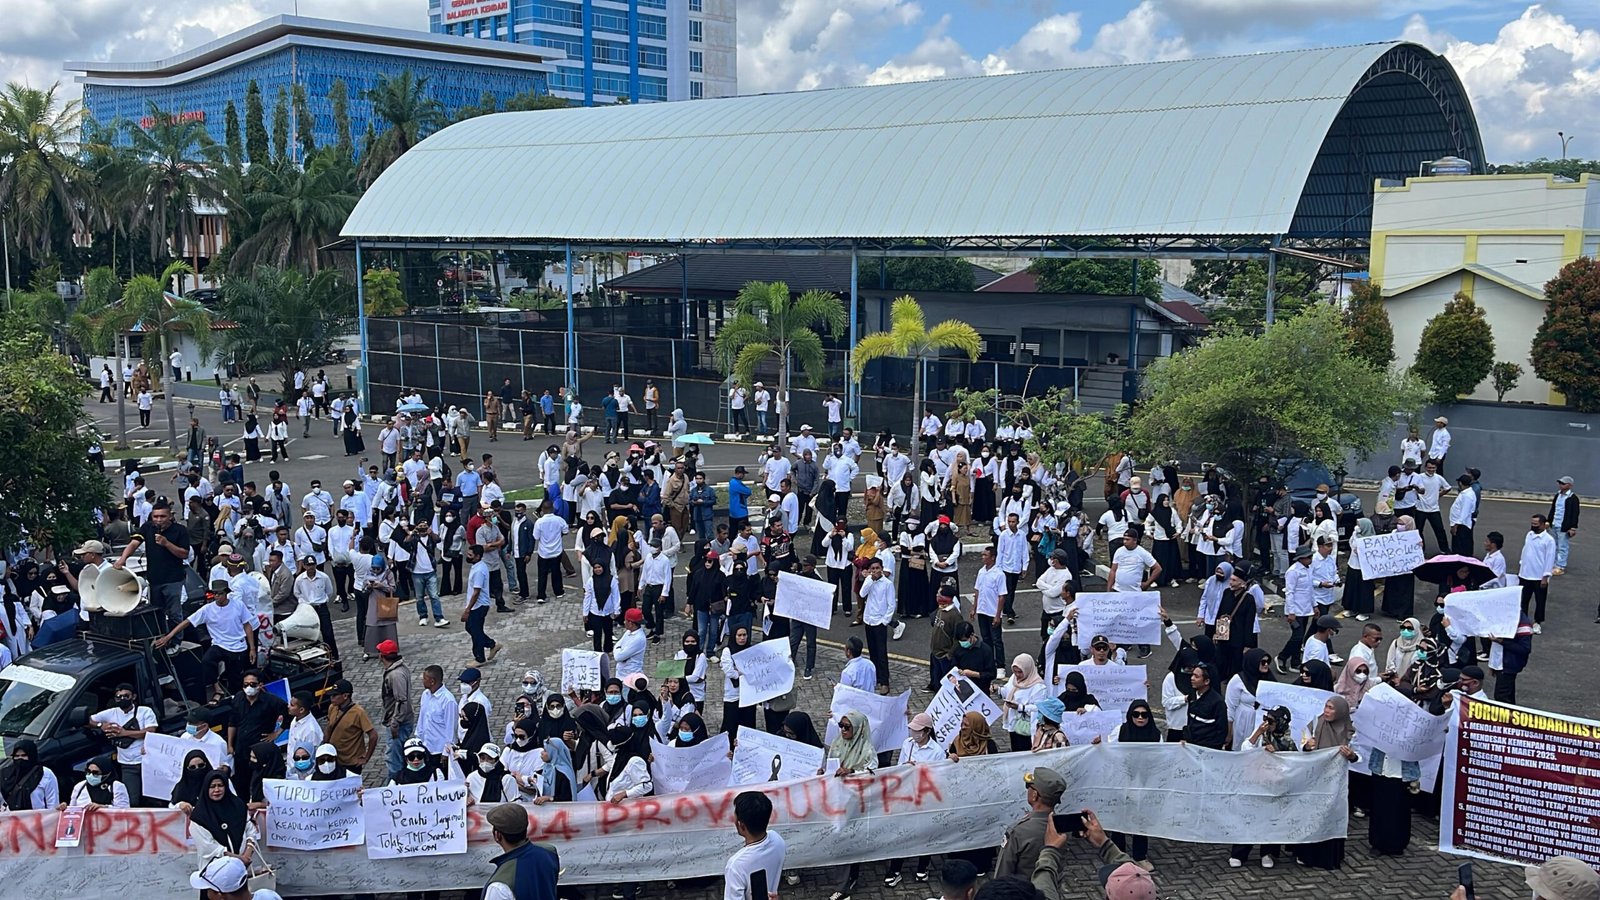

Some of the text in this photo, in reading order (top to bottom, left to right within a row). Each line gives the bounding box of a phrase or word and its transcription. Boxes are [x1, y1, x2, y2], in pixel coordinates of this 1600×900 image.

[480, 2, 508, 14] KENDARI
[1363, 534, 1408, 550] BAPAK
[1468, 701, 1510, 723] FORUM
[1512, 710, 1590, 737] SOLIDARITAS
[1470, 721, 1502, 734] MENOLAK
[1503, 726, 1544, 740] KEPUTUSAN
[1545, 734, 1583, 747] KEMENPAN
[1470, 732, 1507, 745] MENDESAK
[1508, 737, 1545, 751] KEMENPAN
[1557, 745, 1579, 755] TETAP
[1469, 750, 1503, 764] SESEGERA
[1504, 755, 1538, 769] MUNGKIN
[1470, 740, 1490, 751] YAKNI
[1491, 743, 1506, 753] TMT
[1511, 746, 1536, 758] MARET
[1536, 750, 1557, 761] 2025.
[1467, 776, 1505, 791] GUBERNUR
[1505, 783, 1539, 797] PROVINSI
[1540, 790, 1576, 804] SULAWESI
[1468, 767, 1500, 780] MEMINTA
[1543, 781, 1578, 794] PROVINSI
[381, 789, 408, 807] Pak
[1466, 793, 1503, 808] MENERIMA
[1514, 803, 1569, 821] PENGANGKATAN
[1488, 789, 1510, 801] DINAS
[1510, 793, 1544, 807] PROVINSI
[1545, 800, 1567, 811] TETAP
[1465, 812, 1503, 827] SEKALIGUS
[1526, 824, 1559, 838] SEORANG
[1524, 815, 1548, 827] WAKIL
[1547, 820, 1571, 831] KETUA
[1571, 824, 1598, 836] KOMISI
[1480, 824, 1513, 838] ASPIRASI
[1513, 830, 1533, 842] KAMI
[1533, 834, 1555, 846] TIDAK
[1555, 839, 1583, 851] MAMPU
[1480, 833, 1507, 846] SERUAN
[1507, 839, 1527, 850] KAMI
